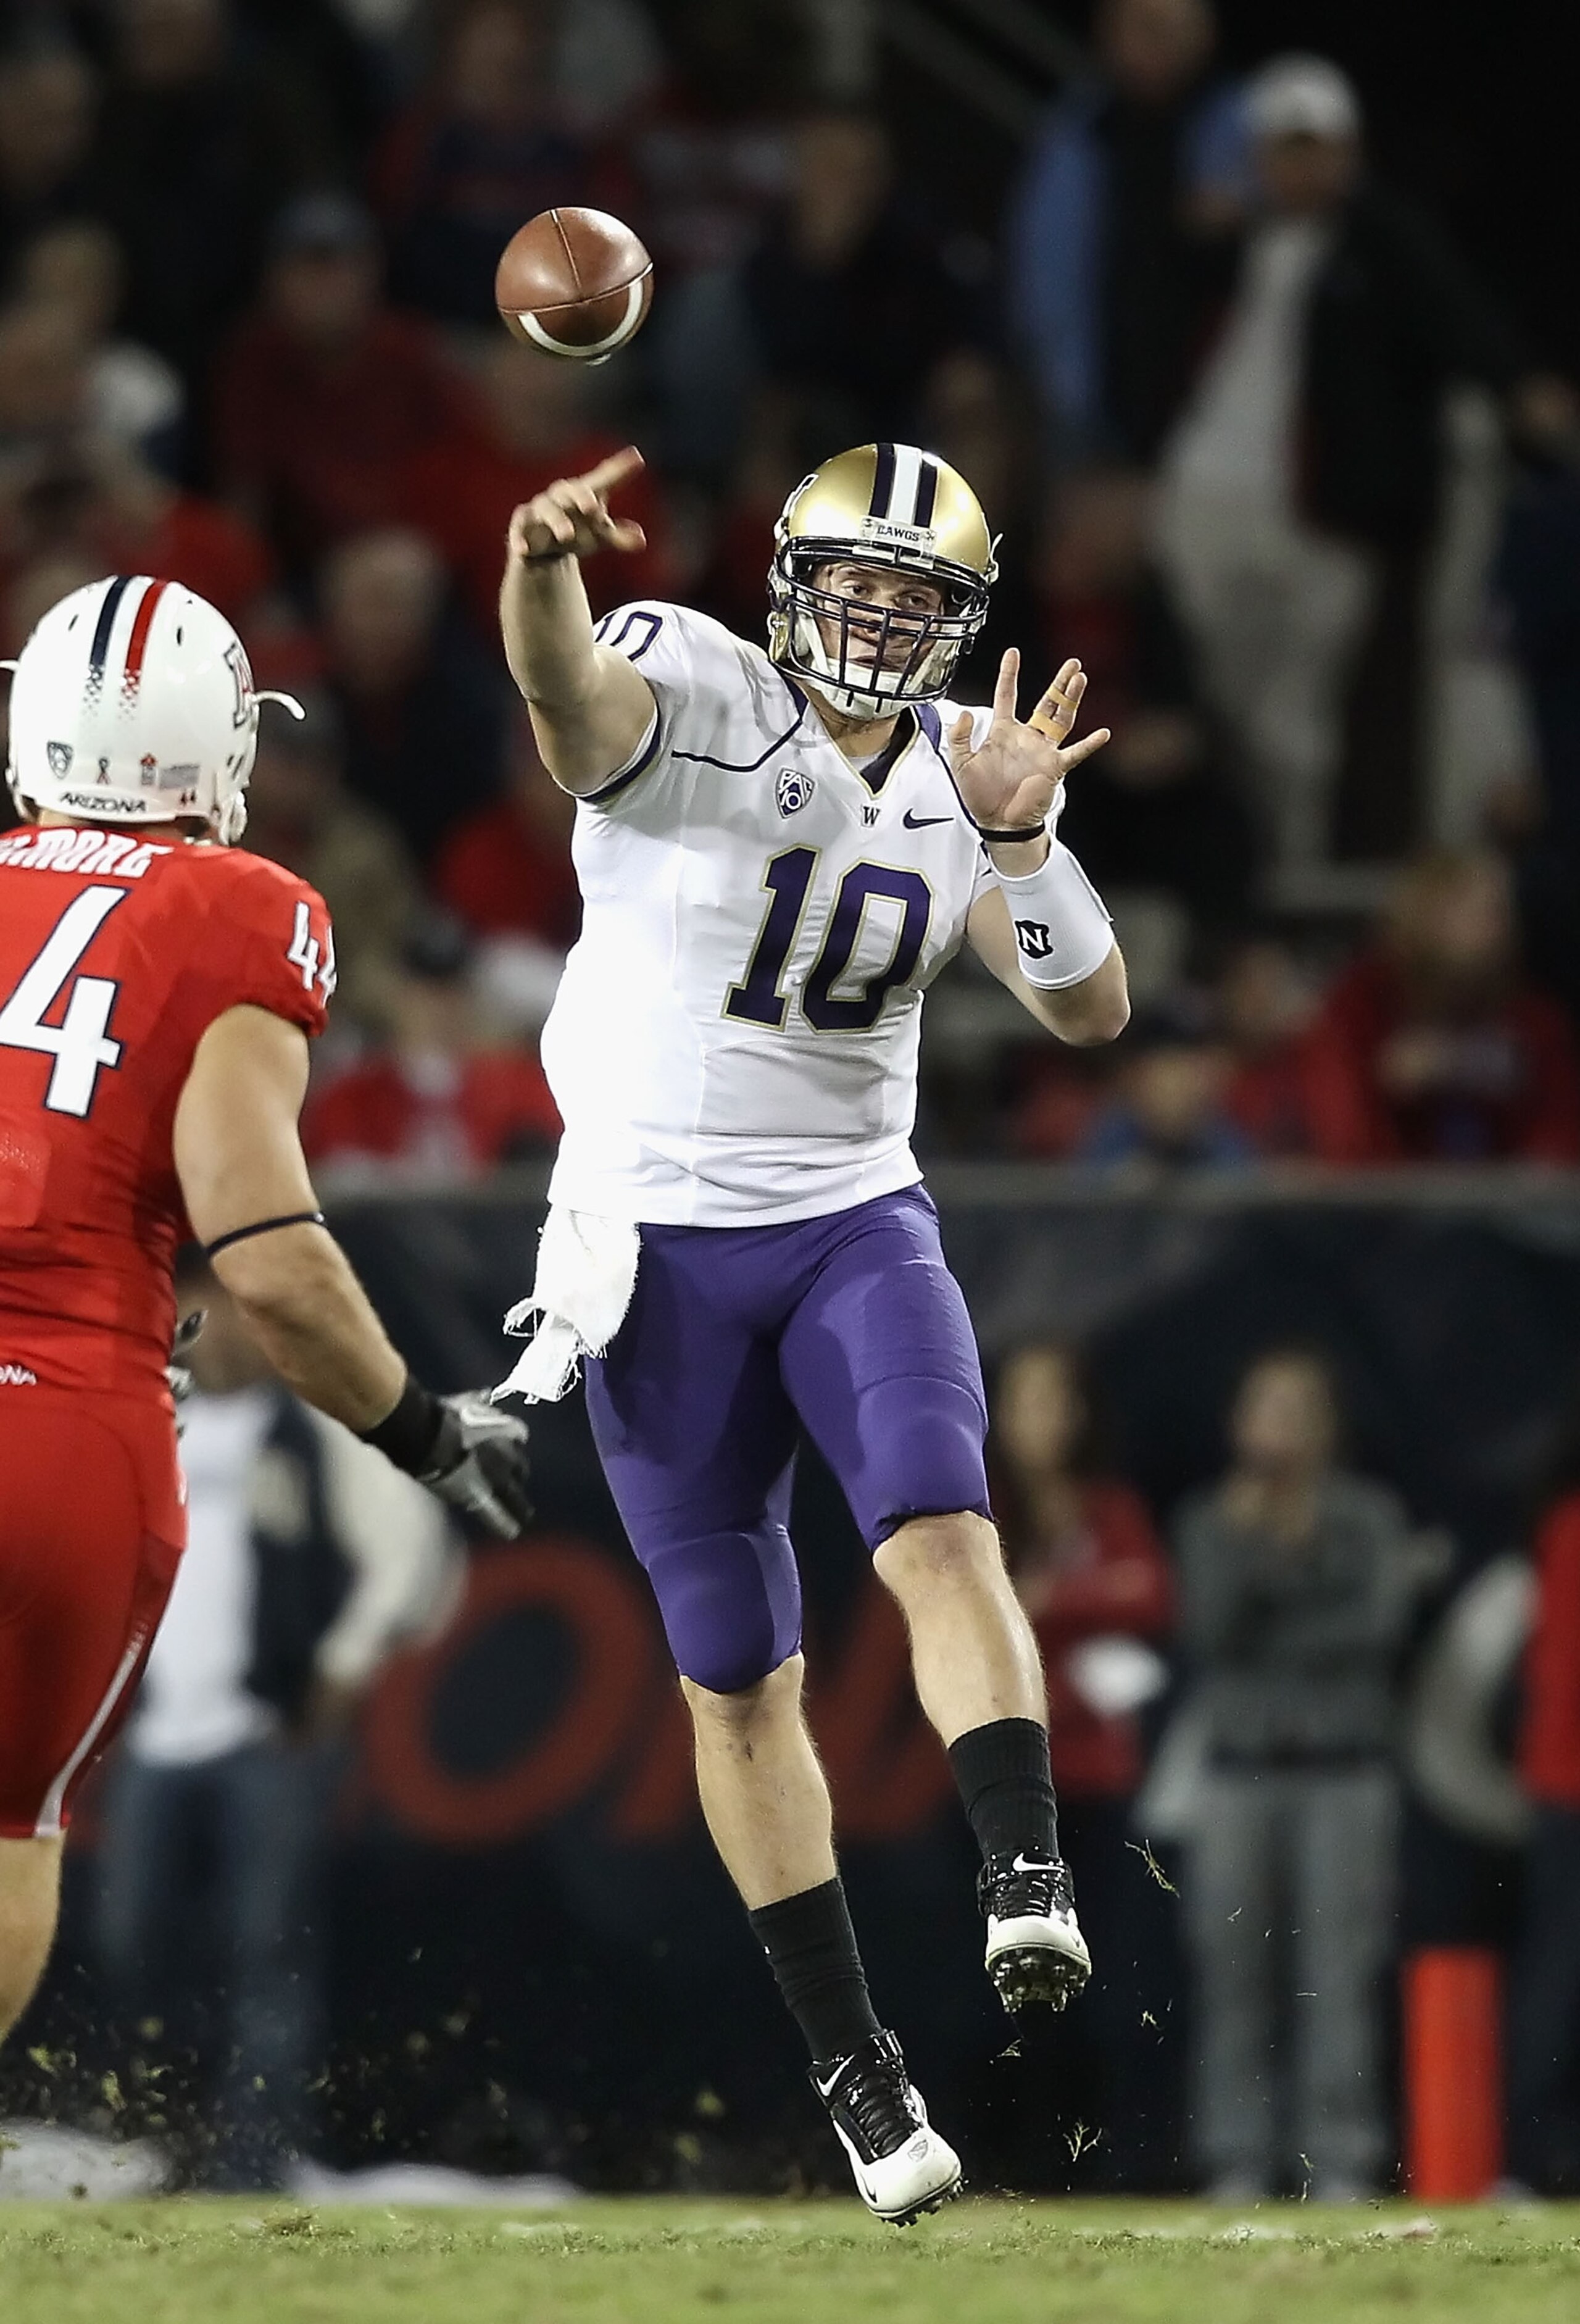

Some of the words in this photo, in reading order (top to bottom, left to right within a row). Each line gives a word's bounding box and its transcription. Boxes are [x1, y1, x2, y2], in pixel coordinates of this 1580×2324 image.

[778, 770, 813, 805] PAC
[780, 788, 802, 810] 10
[60, 792, 146, 812] ARIZONA
[862, 805, 881, 825] W
[720, 842, 936, 1036] 10
[1020, 927, 1046, 951] N
[0, 884, 130, 1120] 4
